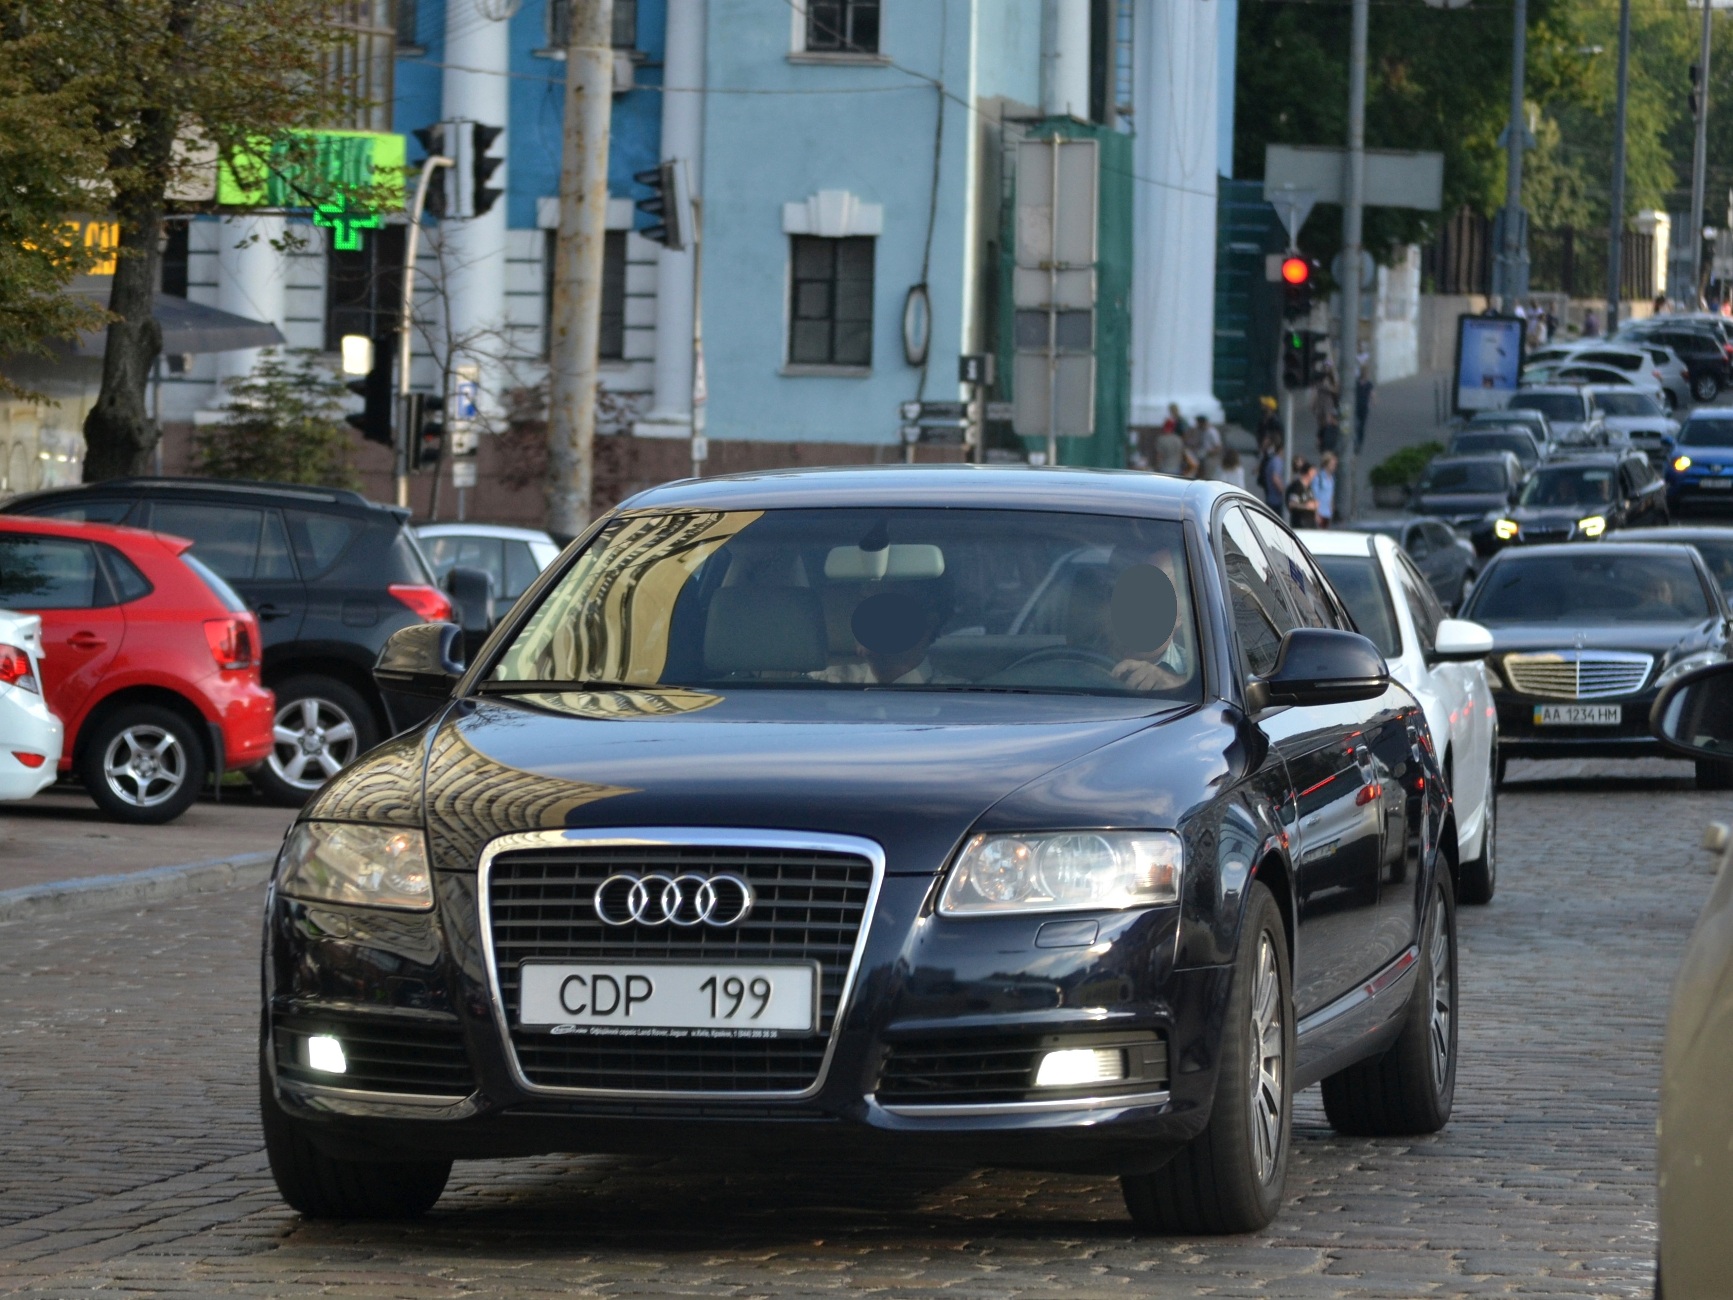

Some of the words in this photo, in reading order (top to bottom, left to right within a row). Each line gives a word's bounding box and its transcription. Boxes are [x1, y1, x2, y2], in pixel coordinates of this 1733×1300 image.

[1543, 708, 1561, 720] AA
[1566, 708, 1595, 721] 1234
[1598, 708, 1617, 720] HM
[559, 974, 654, 1017] CDP
[699, 975, 773, 1020] 199
